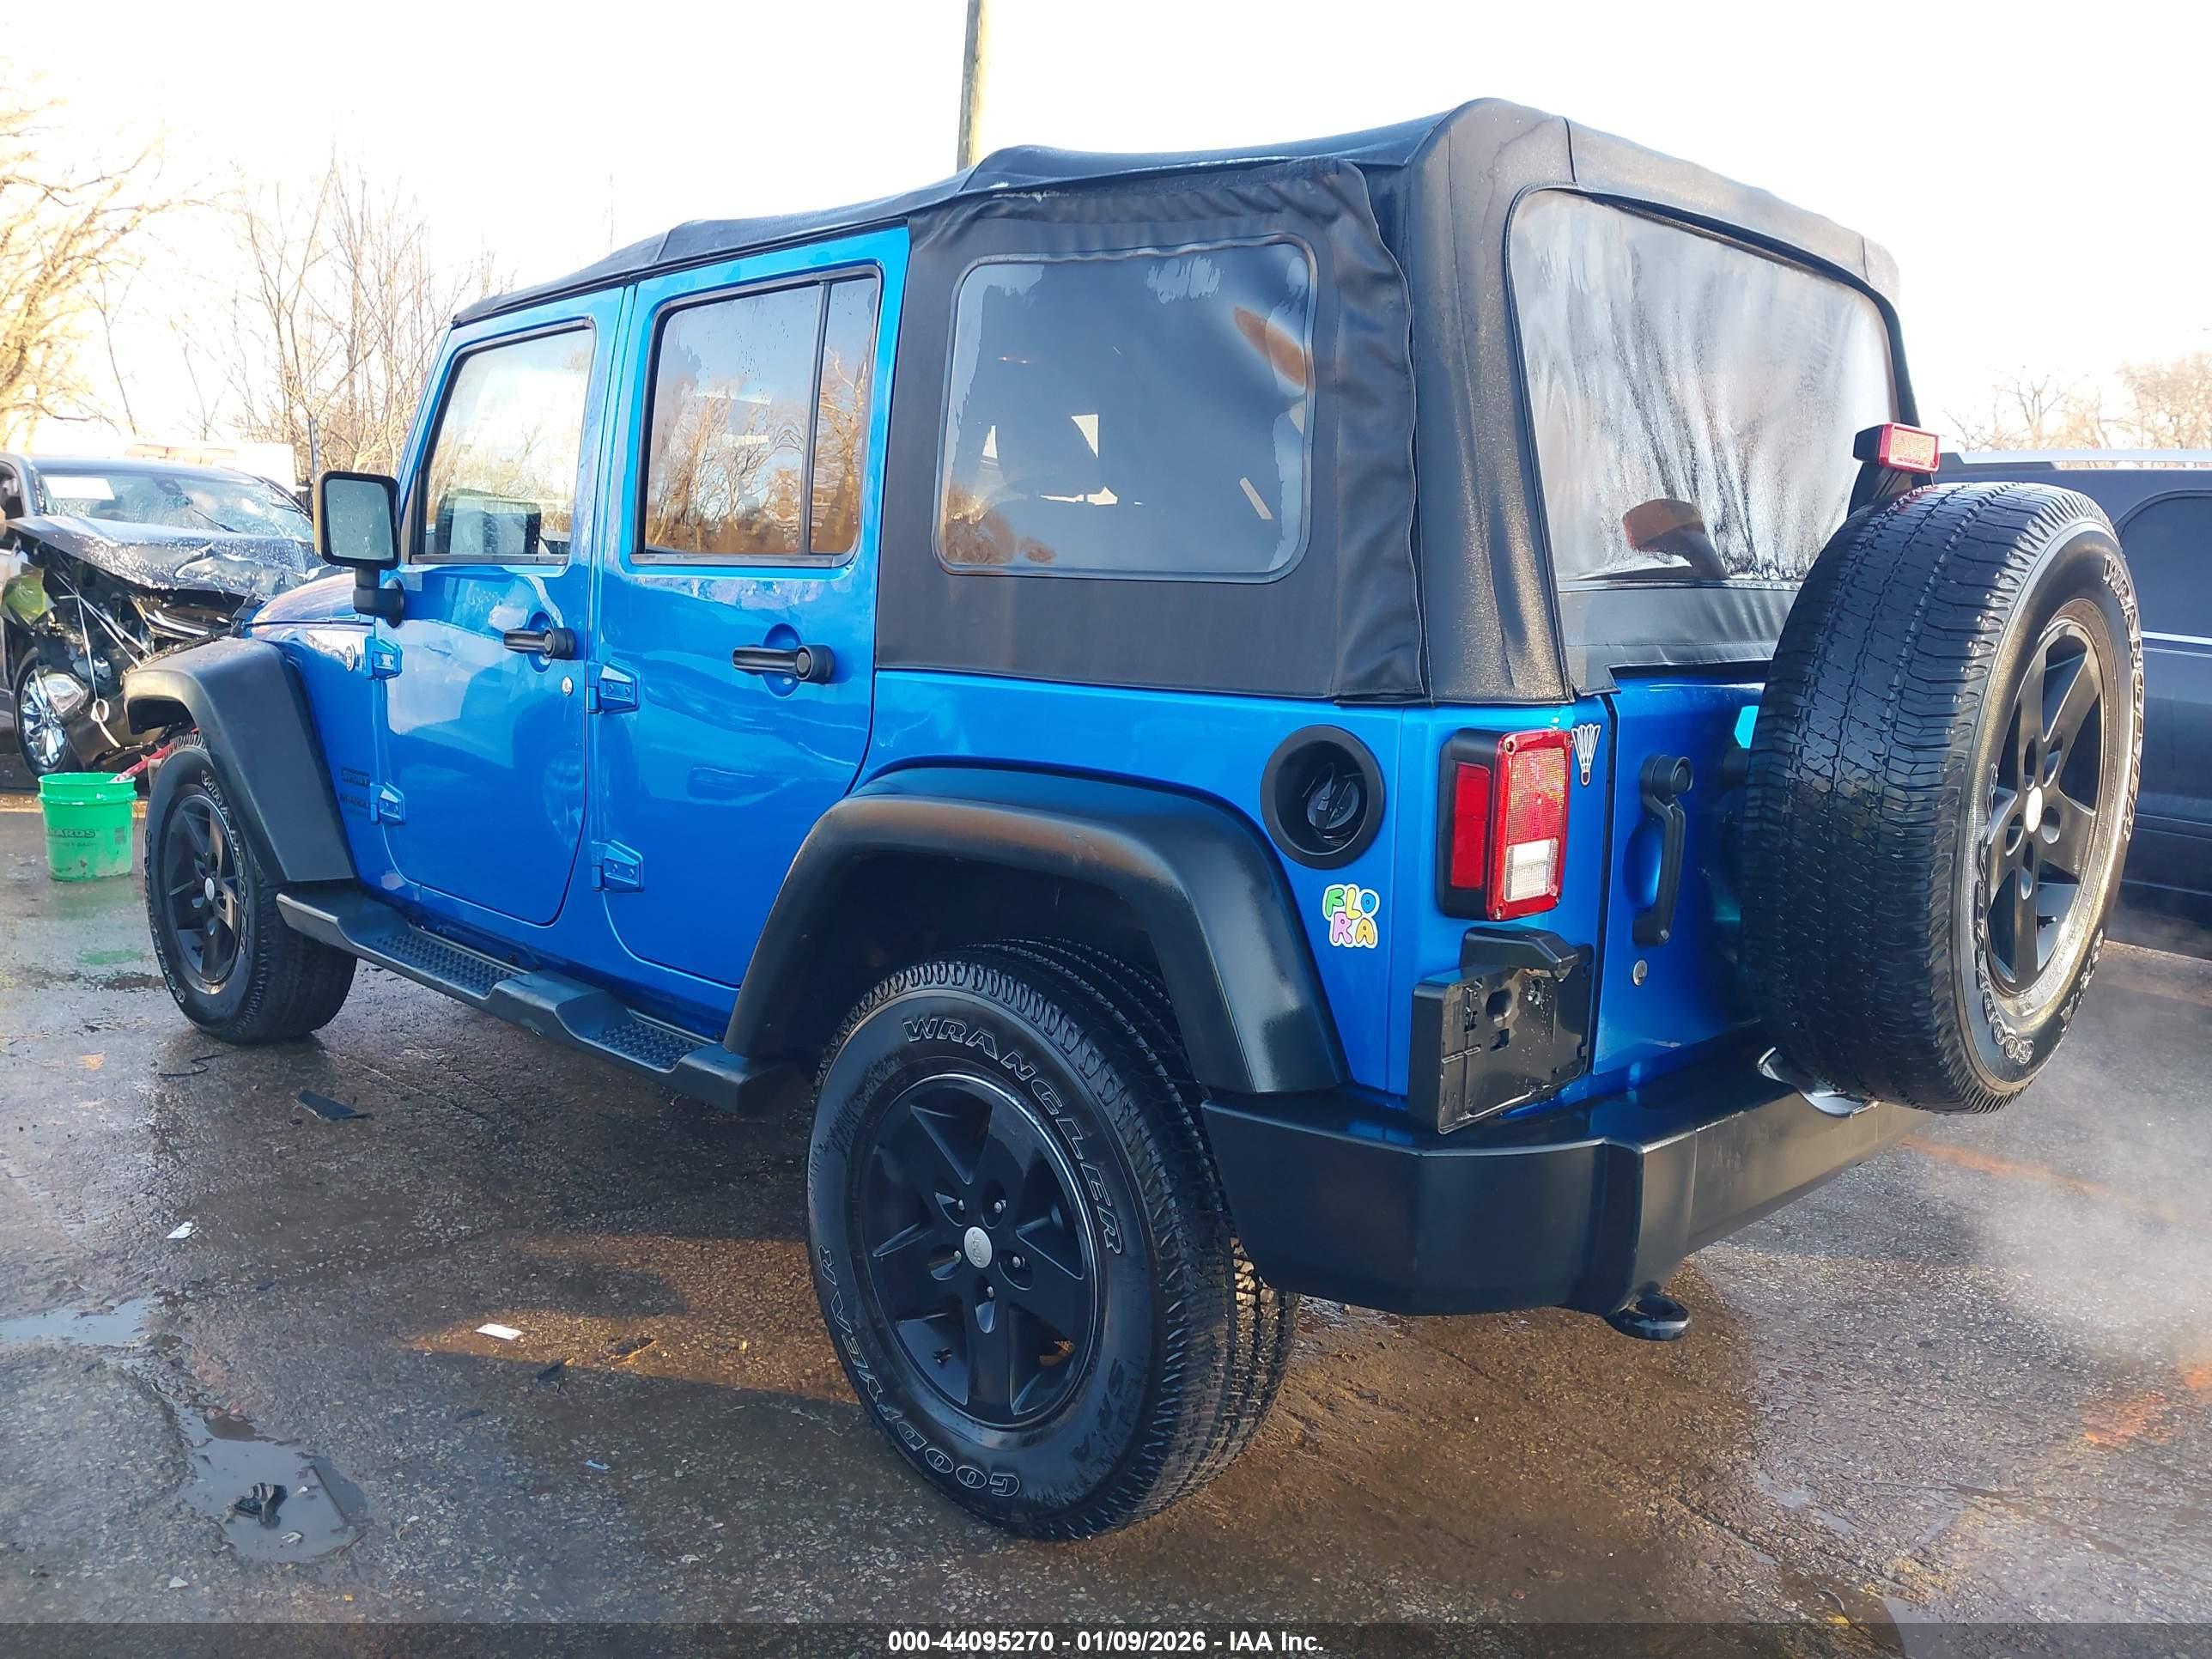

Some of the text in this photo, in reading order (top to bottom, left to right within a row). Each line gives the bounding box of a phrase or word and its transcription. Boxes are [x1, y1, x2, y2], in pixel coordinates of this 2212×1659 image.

[2100, 555, 2145, 843] WRANGLER
[1324, 886, 1376, 920] FLO
[1332, 911, 1376, 945] RA
[902, 1016, 1124, 1256] WRANGLER
[820, 1243, 1021, 1498] GOODYEAR
